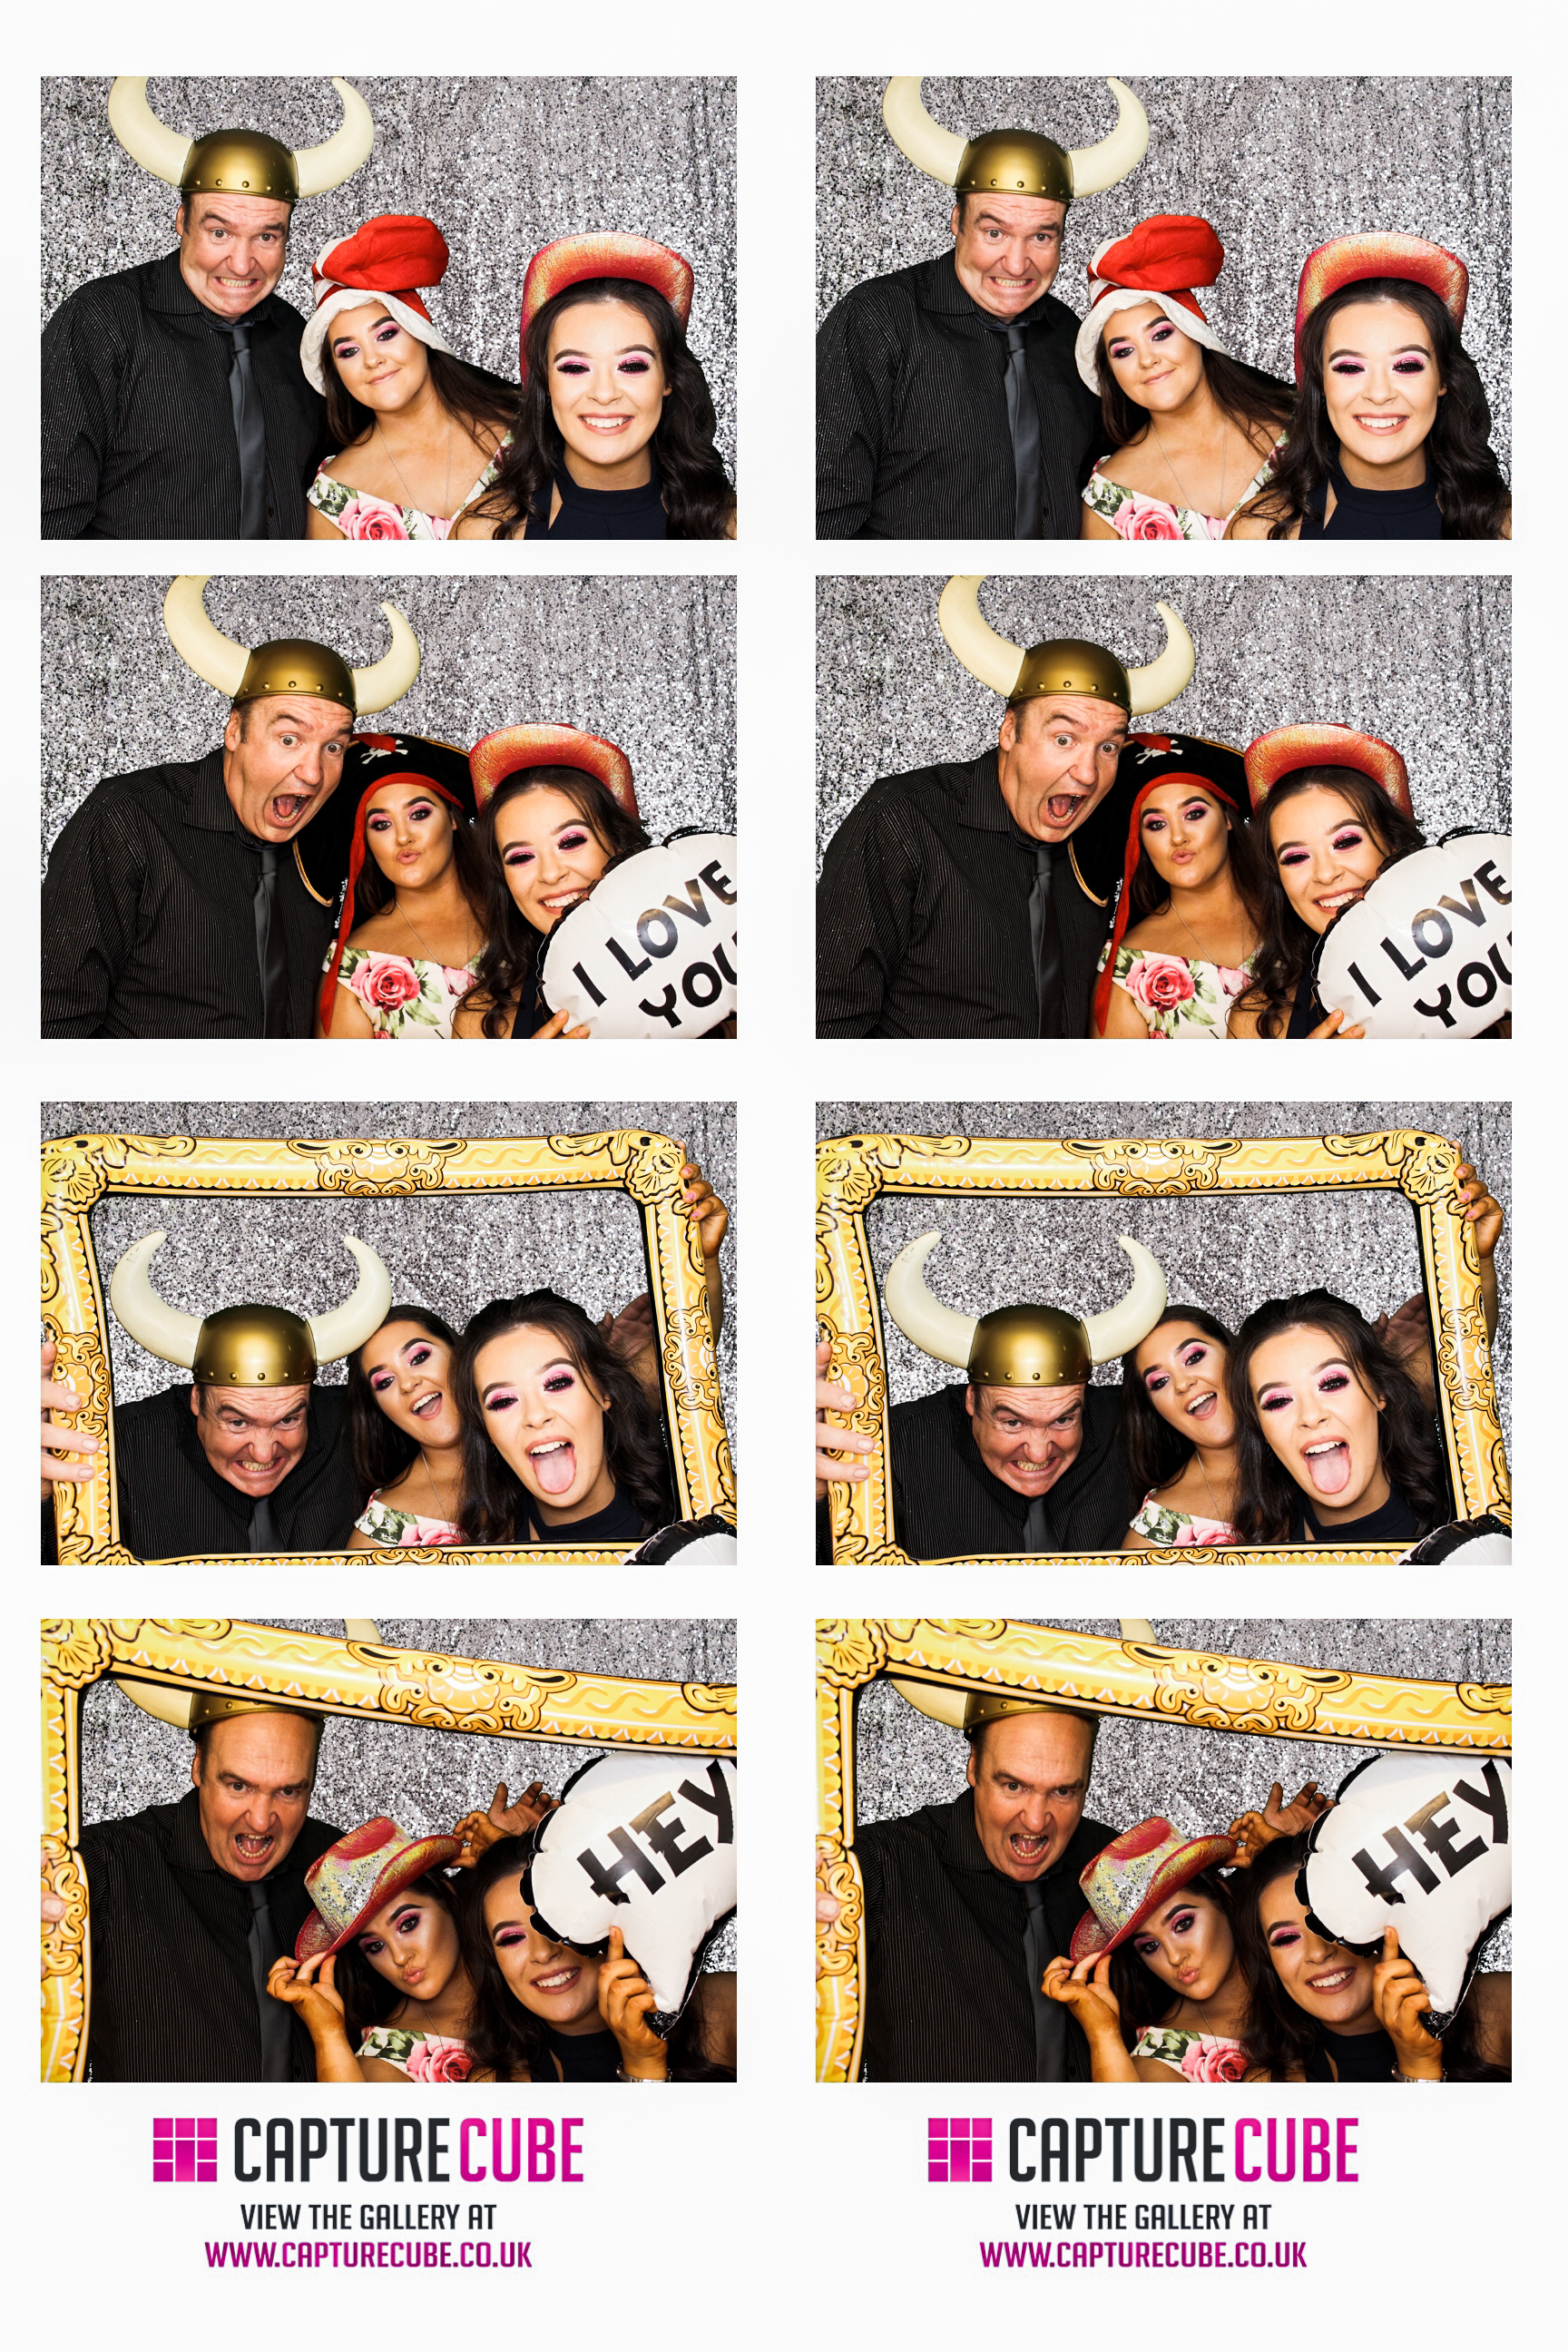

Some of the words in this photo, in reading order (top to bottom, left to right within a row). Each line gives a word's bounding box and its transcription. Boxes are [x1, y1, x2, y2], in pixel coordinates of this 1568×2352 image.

[573, 962, 607, 1007] I
[605, 859, 737, 981] LOVE
[1348, 962, 1382, 1007] I
[1380, 859, 1512, 981] LOVE
[576, 1759, 733, 1906] HEY
[1351, 1759, 1508, 1906] HEY
